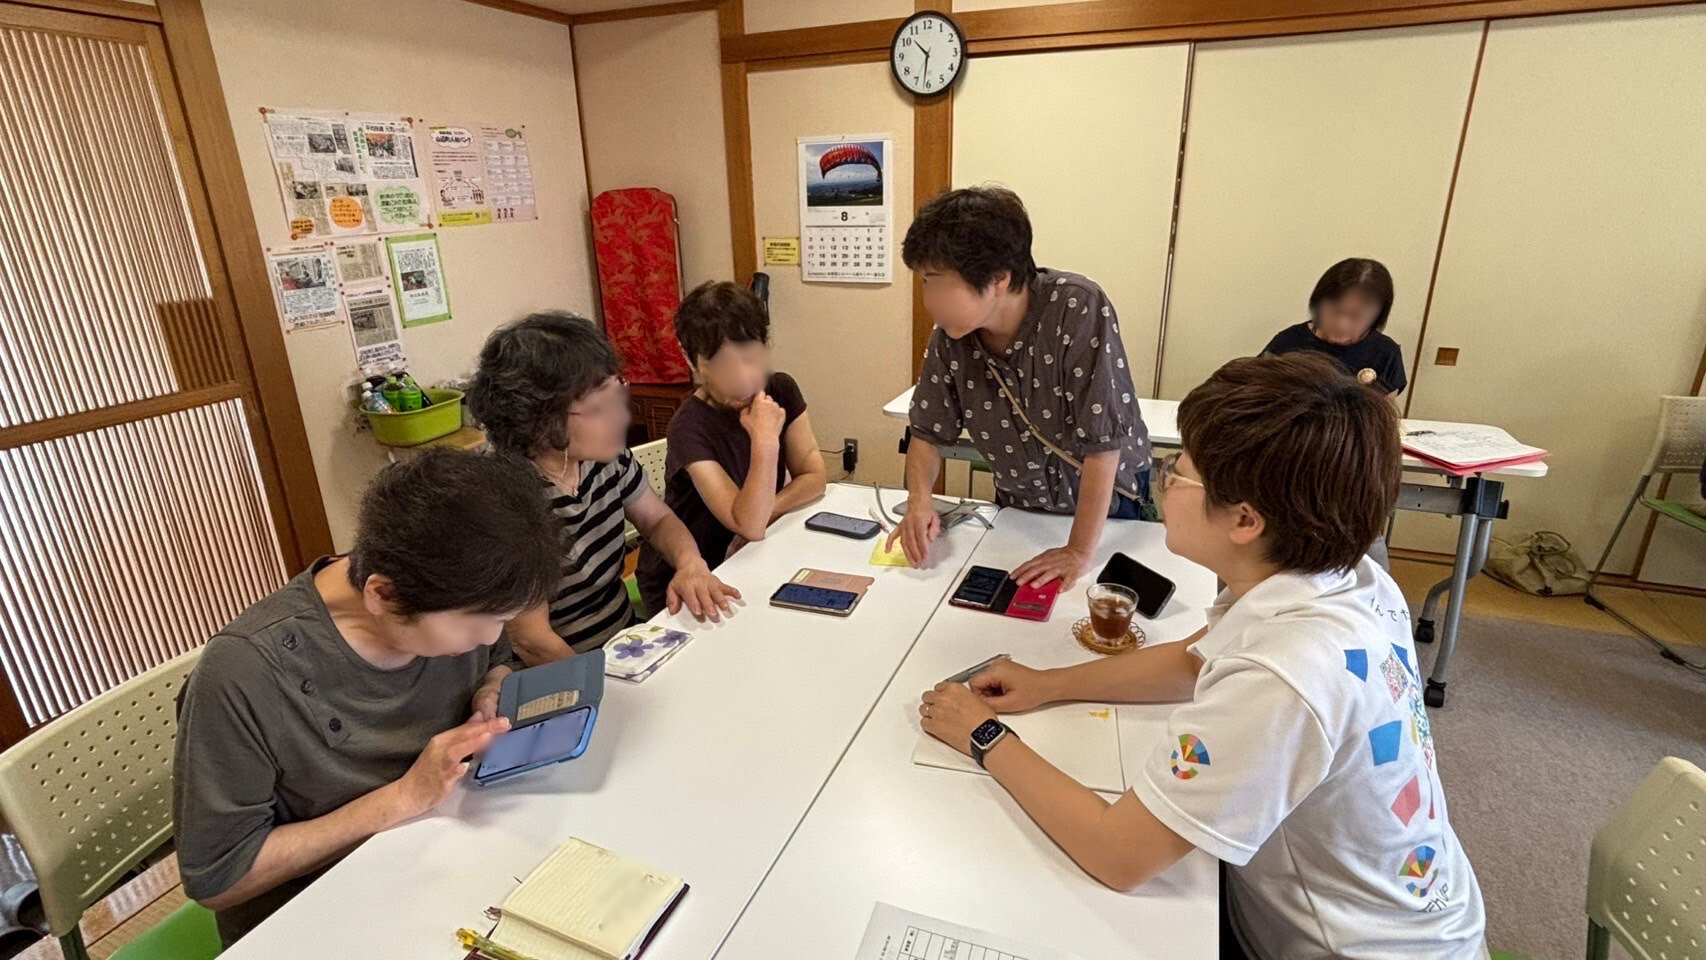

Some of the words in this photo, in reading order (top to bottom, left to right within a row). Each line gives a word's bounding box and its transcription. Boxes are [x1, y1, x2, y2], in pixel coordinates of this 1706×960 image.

[923, 20, 932, 30] 12
[939, 23, 943, 32] 1
[910, 26, 918, 35] 11
[902, 37, 911, 47] 10
[948, 33, 953, 42] 2
[899, 53, 904, 61] 9
[953, 48, 958, 57] 3
[904, 66, 910, 75] 8
[948, 63, 953, 72] 4
[914, 76, 919, 85] 7
[939, 75, 944, 83] 5
[841, 211, 848, 221] 8
